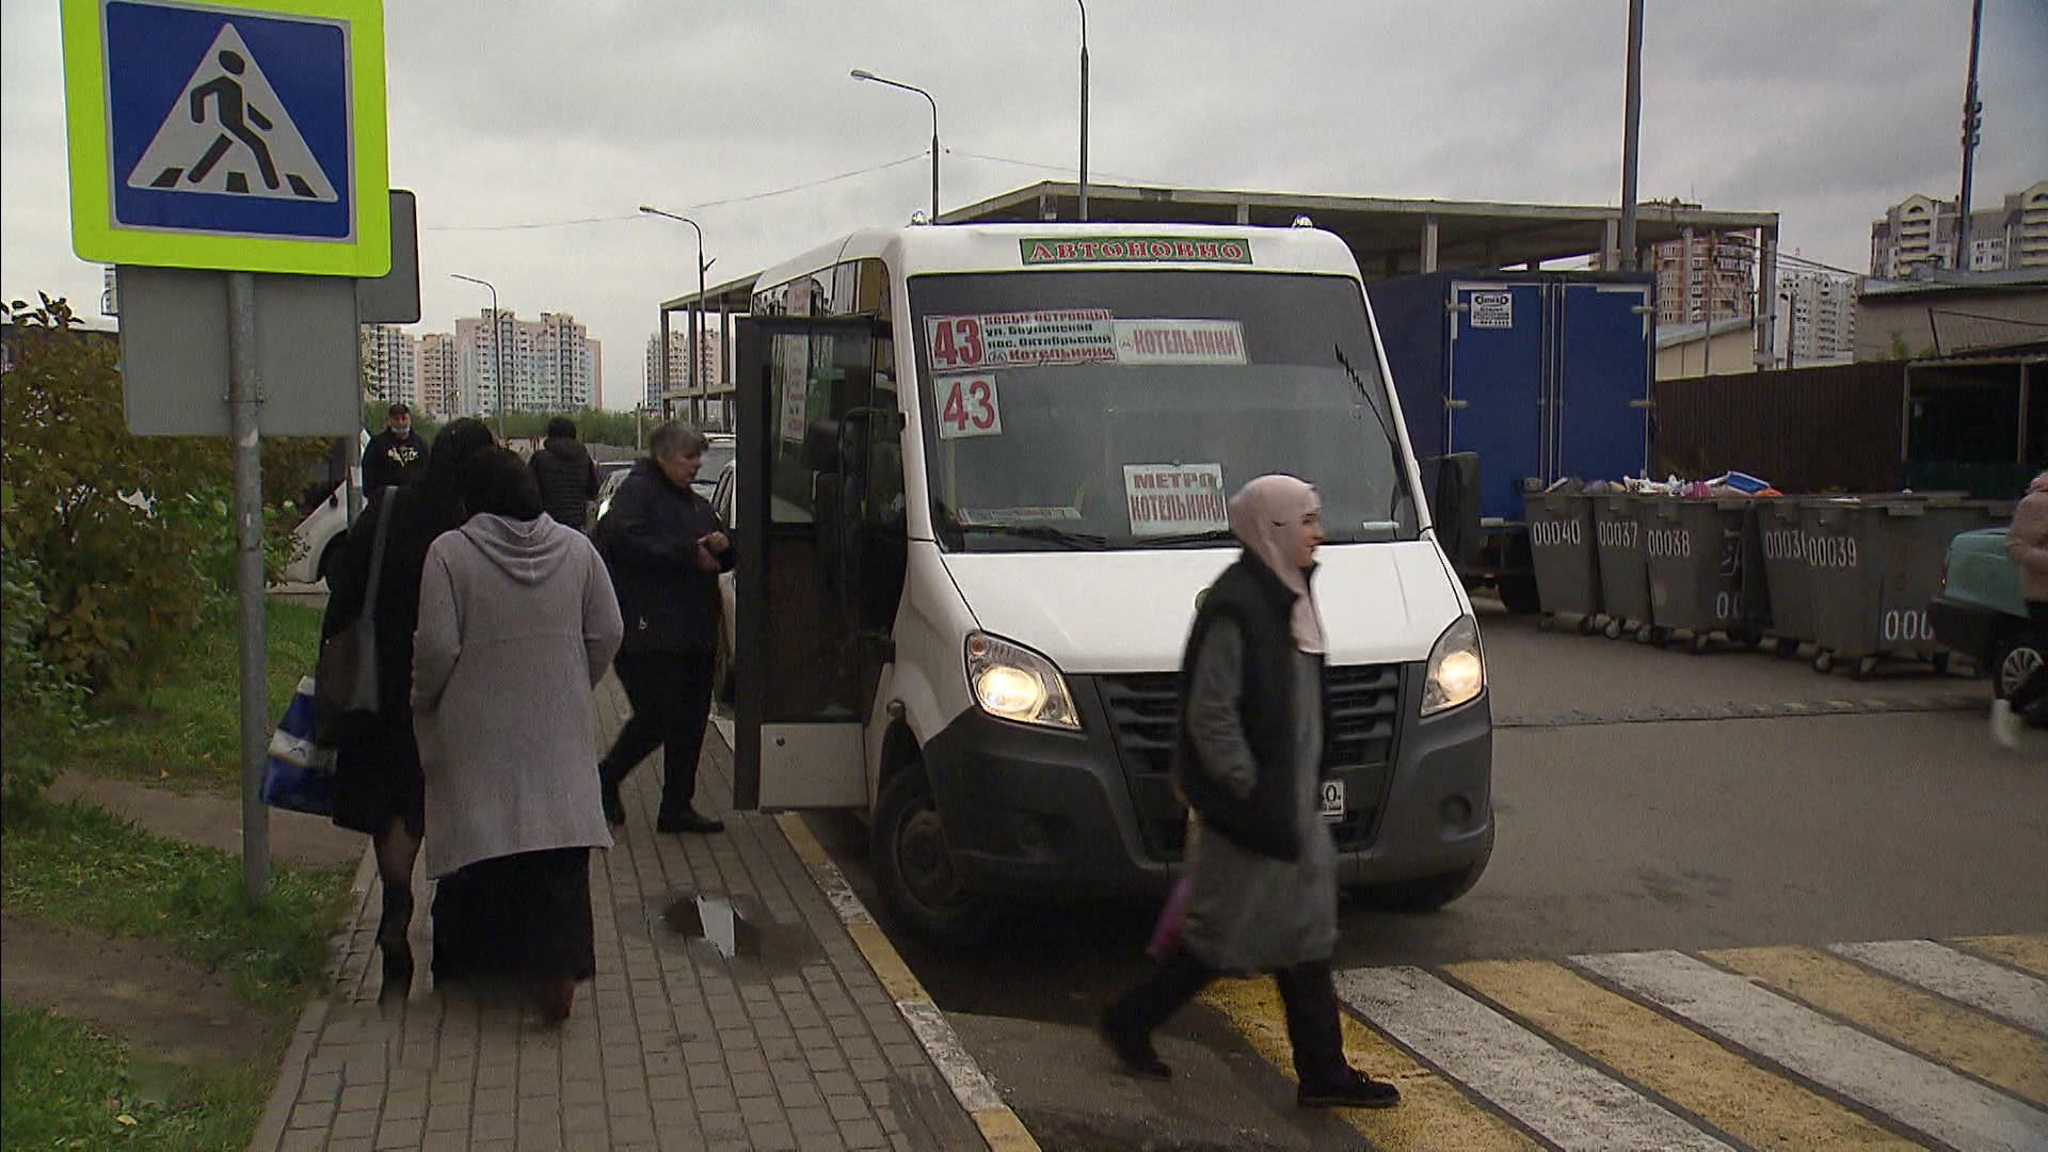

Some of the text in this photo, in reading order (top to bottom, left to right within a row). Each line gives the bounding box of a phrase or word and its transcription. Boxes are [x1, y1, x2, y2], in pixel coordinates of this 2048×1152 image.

[934, 320, 983, 366] 43
[985, 327, 1006, 338] ул.
[1134, 329, 1237, 356] КОТЕЛЬНИКИ
[943, 381, 994, 430] 43
[1533, 520, 1581, 545] 00040
[1599, 521, 1638, 547] 00037
[1648, 529, 1691, 556] 00038
[1808, 536, 1856, 567] 00039
